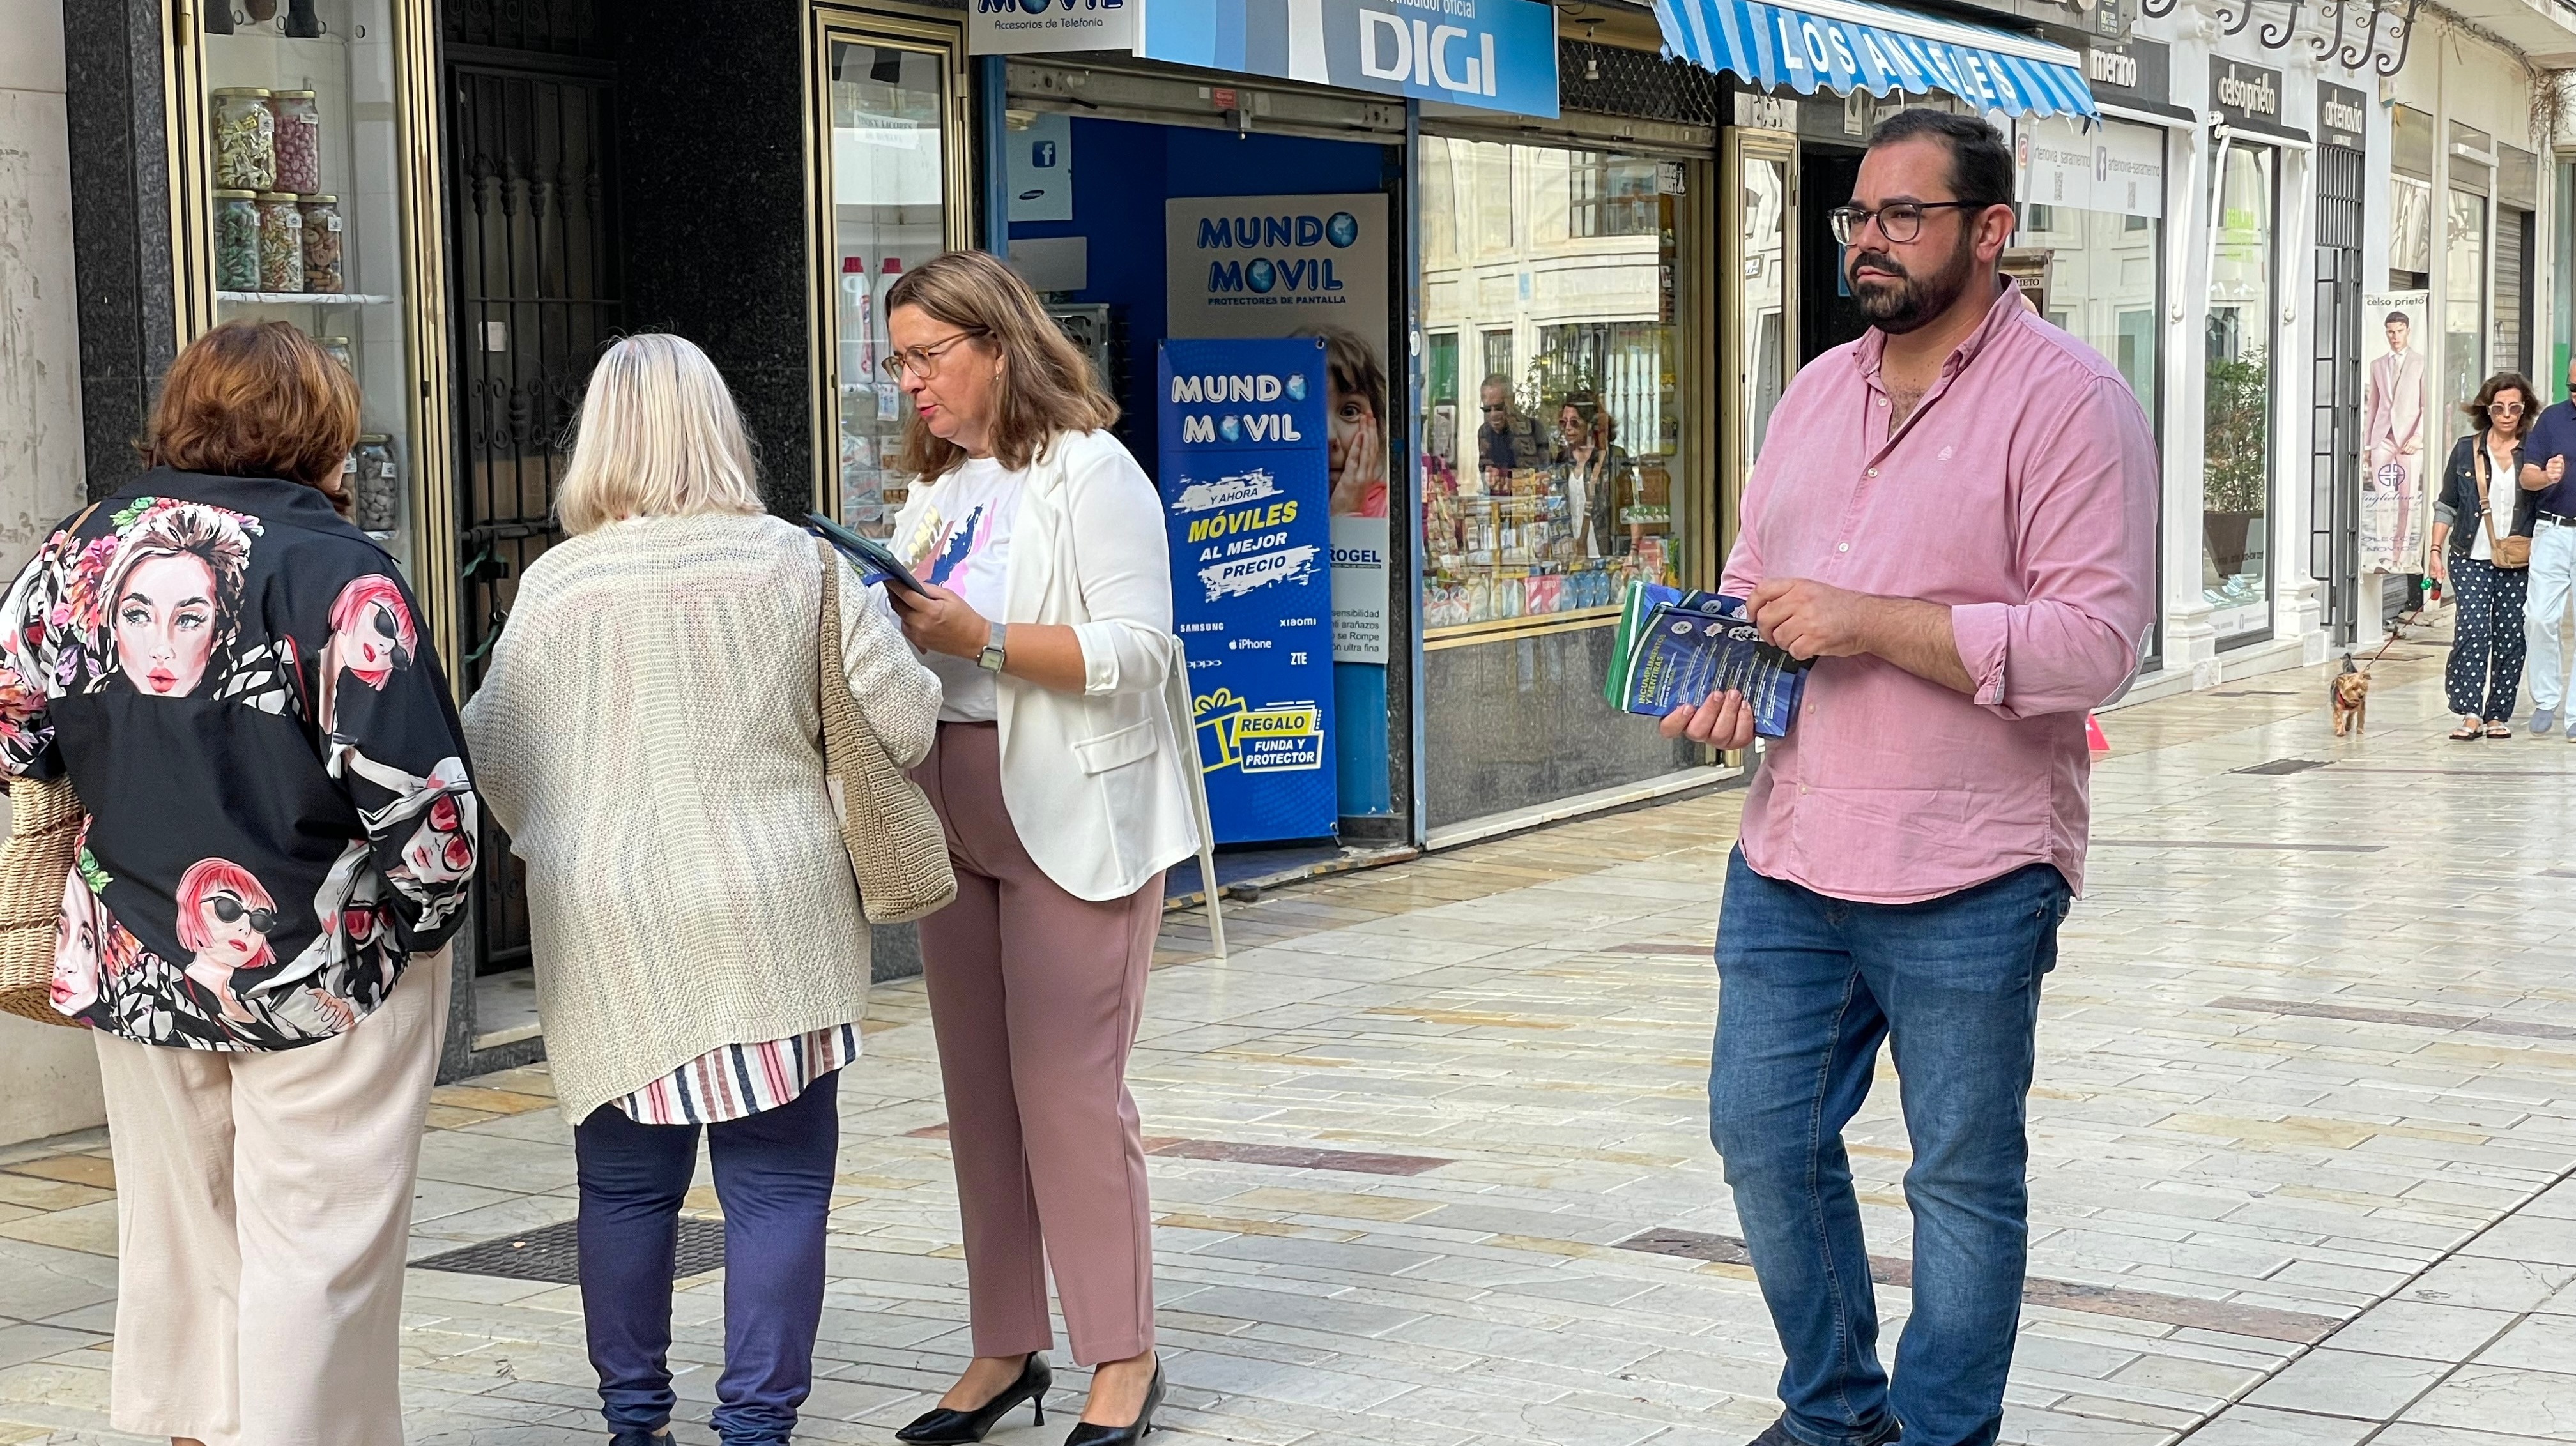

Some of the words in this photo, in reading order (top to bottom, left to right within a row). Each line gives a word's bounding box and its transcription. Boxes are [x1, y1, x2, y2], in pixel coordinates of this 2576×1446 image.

[1443, 0, 1475, 19] oficial
[995, 20, 1043, 29] Accesorios
[1045, 18, 1057, 28] de
[1061, 17, 1103, 27] Telefonía
[1360, 8, 1496, 97] DIGI
[1777, 17, 1856, 75] LOS
[1862, 33, 2016, 100] ANGELES
[2218, 63, 2246, 108] celso
[2243, 73, 2275, 119] prieto
[2323, 88, 2363, 134] artenovia
[1197, 211, 1358, 248] MUNDO
[1208, 257, 1344, 294] MOVIL
[1208, 296, 1277, 306] PROTECTORES
[1296, 296, 1346, 304] PANTALLA
[2367, 297, 2391, 305] celso
[2395, 297, 2424, 308] prieto
[1171, 372, 1310, 403] MUNDO
[1183, 413, 1301, 443] MOVIL
[1210, 496, 1217, 505] Y
[1218, 487, 1258, 503] AHORA
[1188, 501, 1298, 543] MÓVILES
[1199, 546, 1222, 562] AL
[1227, 531, 1287, 556] MEJOR
[1222, 556, 1286, 580] PRECIO
[1180, 622, 1224, 632] SAMSUNG
[1342, 621, 1379, 629] arañazos
[1239, 639, 1272, 649] iPhone
[1349, 632, 1379, 642] Rompe
[1364, 643, 1379, 652] fina
[1291, 652, 1307, 665] ZTE
[1648, 656, 1664, 698] MENTIRAS
[1241, 715, 1305, 732] REGALO
[1255, 739, 1294, 752] FUNDA
[1297, 738, 1306, 750] Y
[1246, 751, 1315, 766] PROTECTOR
